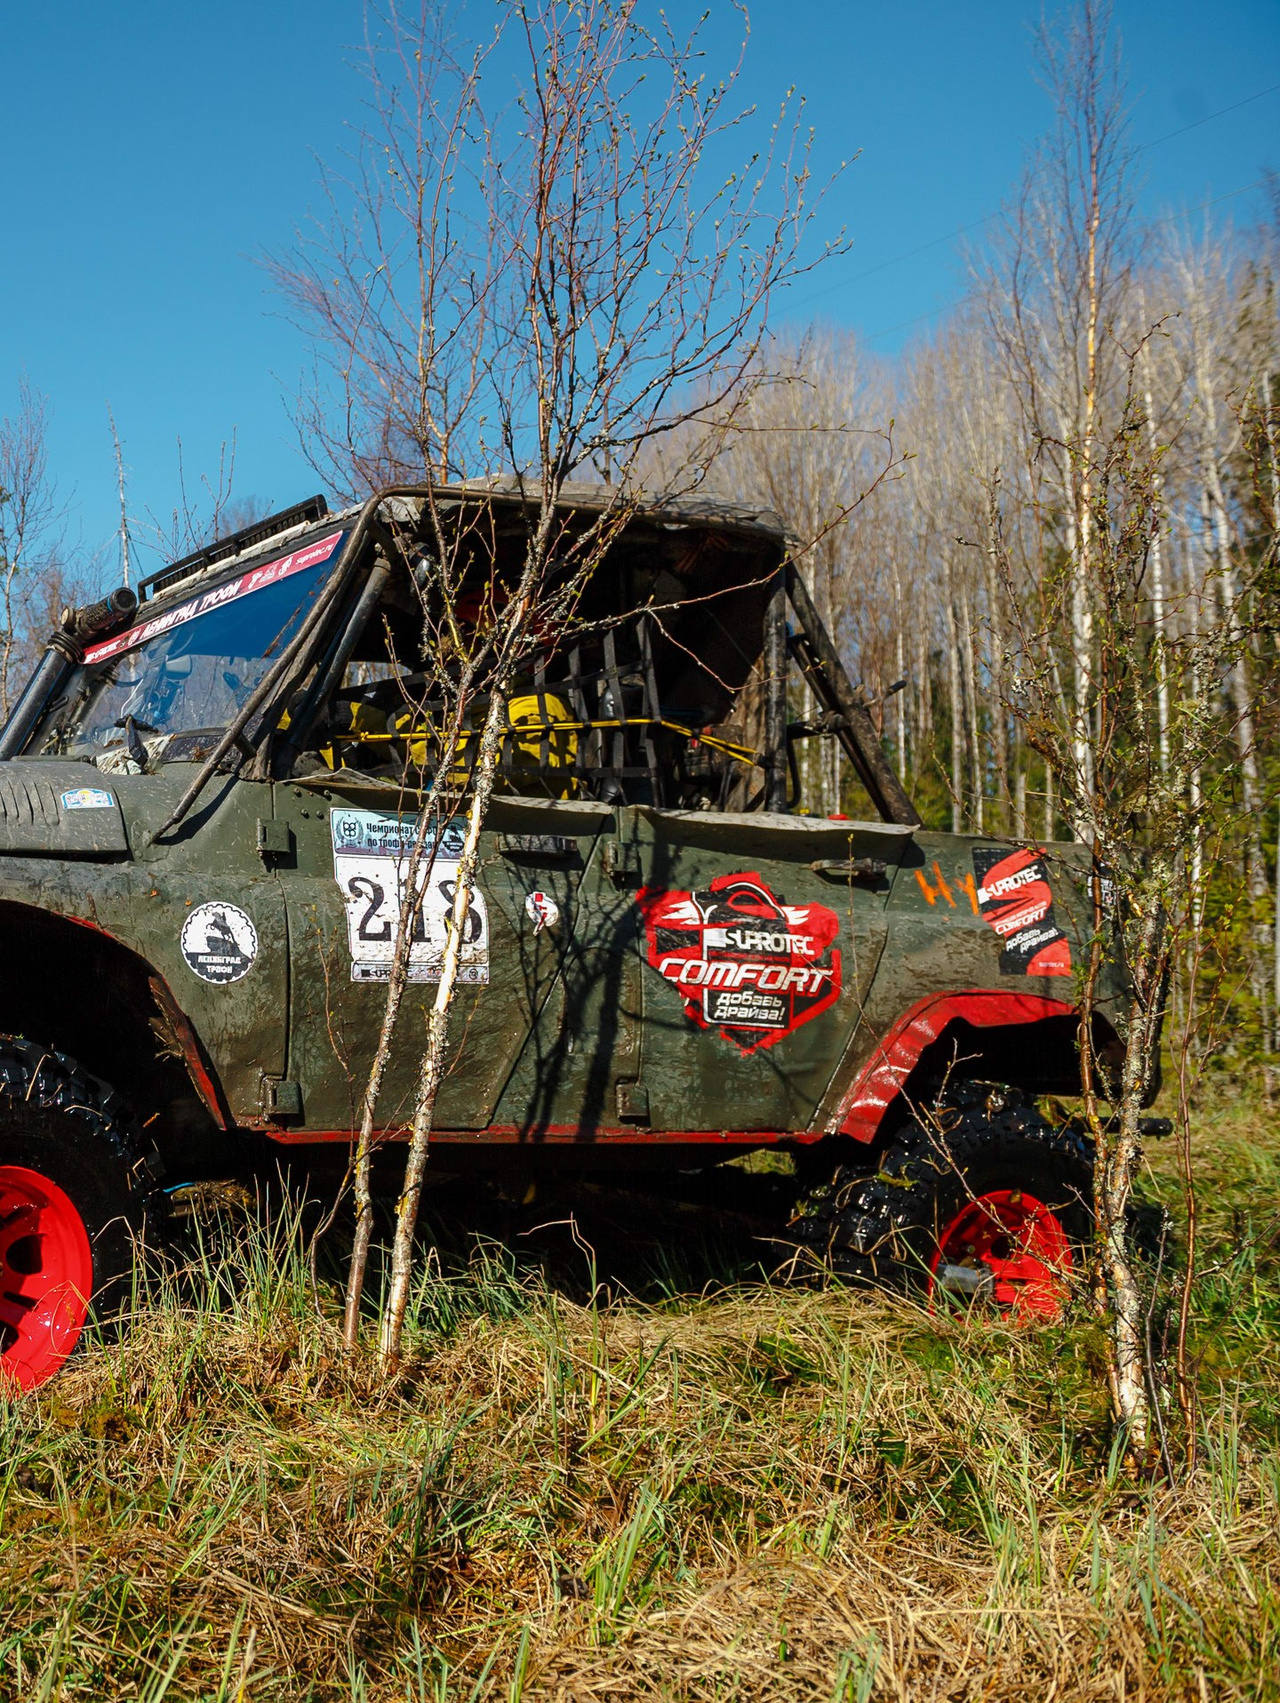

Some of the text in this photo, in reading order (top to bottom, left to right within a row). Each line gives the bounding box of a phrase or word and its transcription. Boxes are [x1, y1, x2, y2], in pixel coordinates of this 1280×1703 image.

[366, 822, 414, 835] Чемпионат
[985, 865, 1041, 897] SUPROTEC
[995, 907, 1047, 935] COMFORT
[725, 929, 814, 955] SUPROTEC
[658, 957, 834, 993] COMFORT
